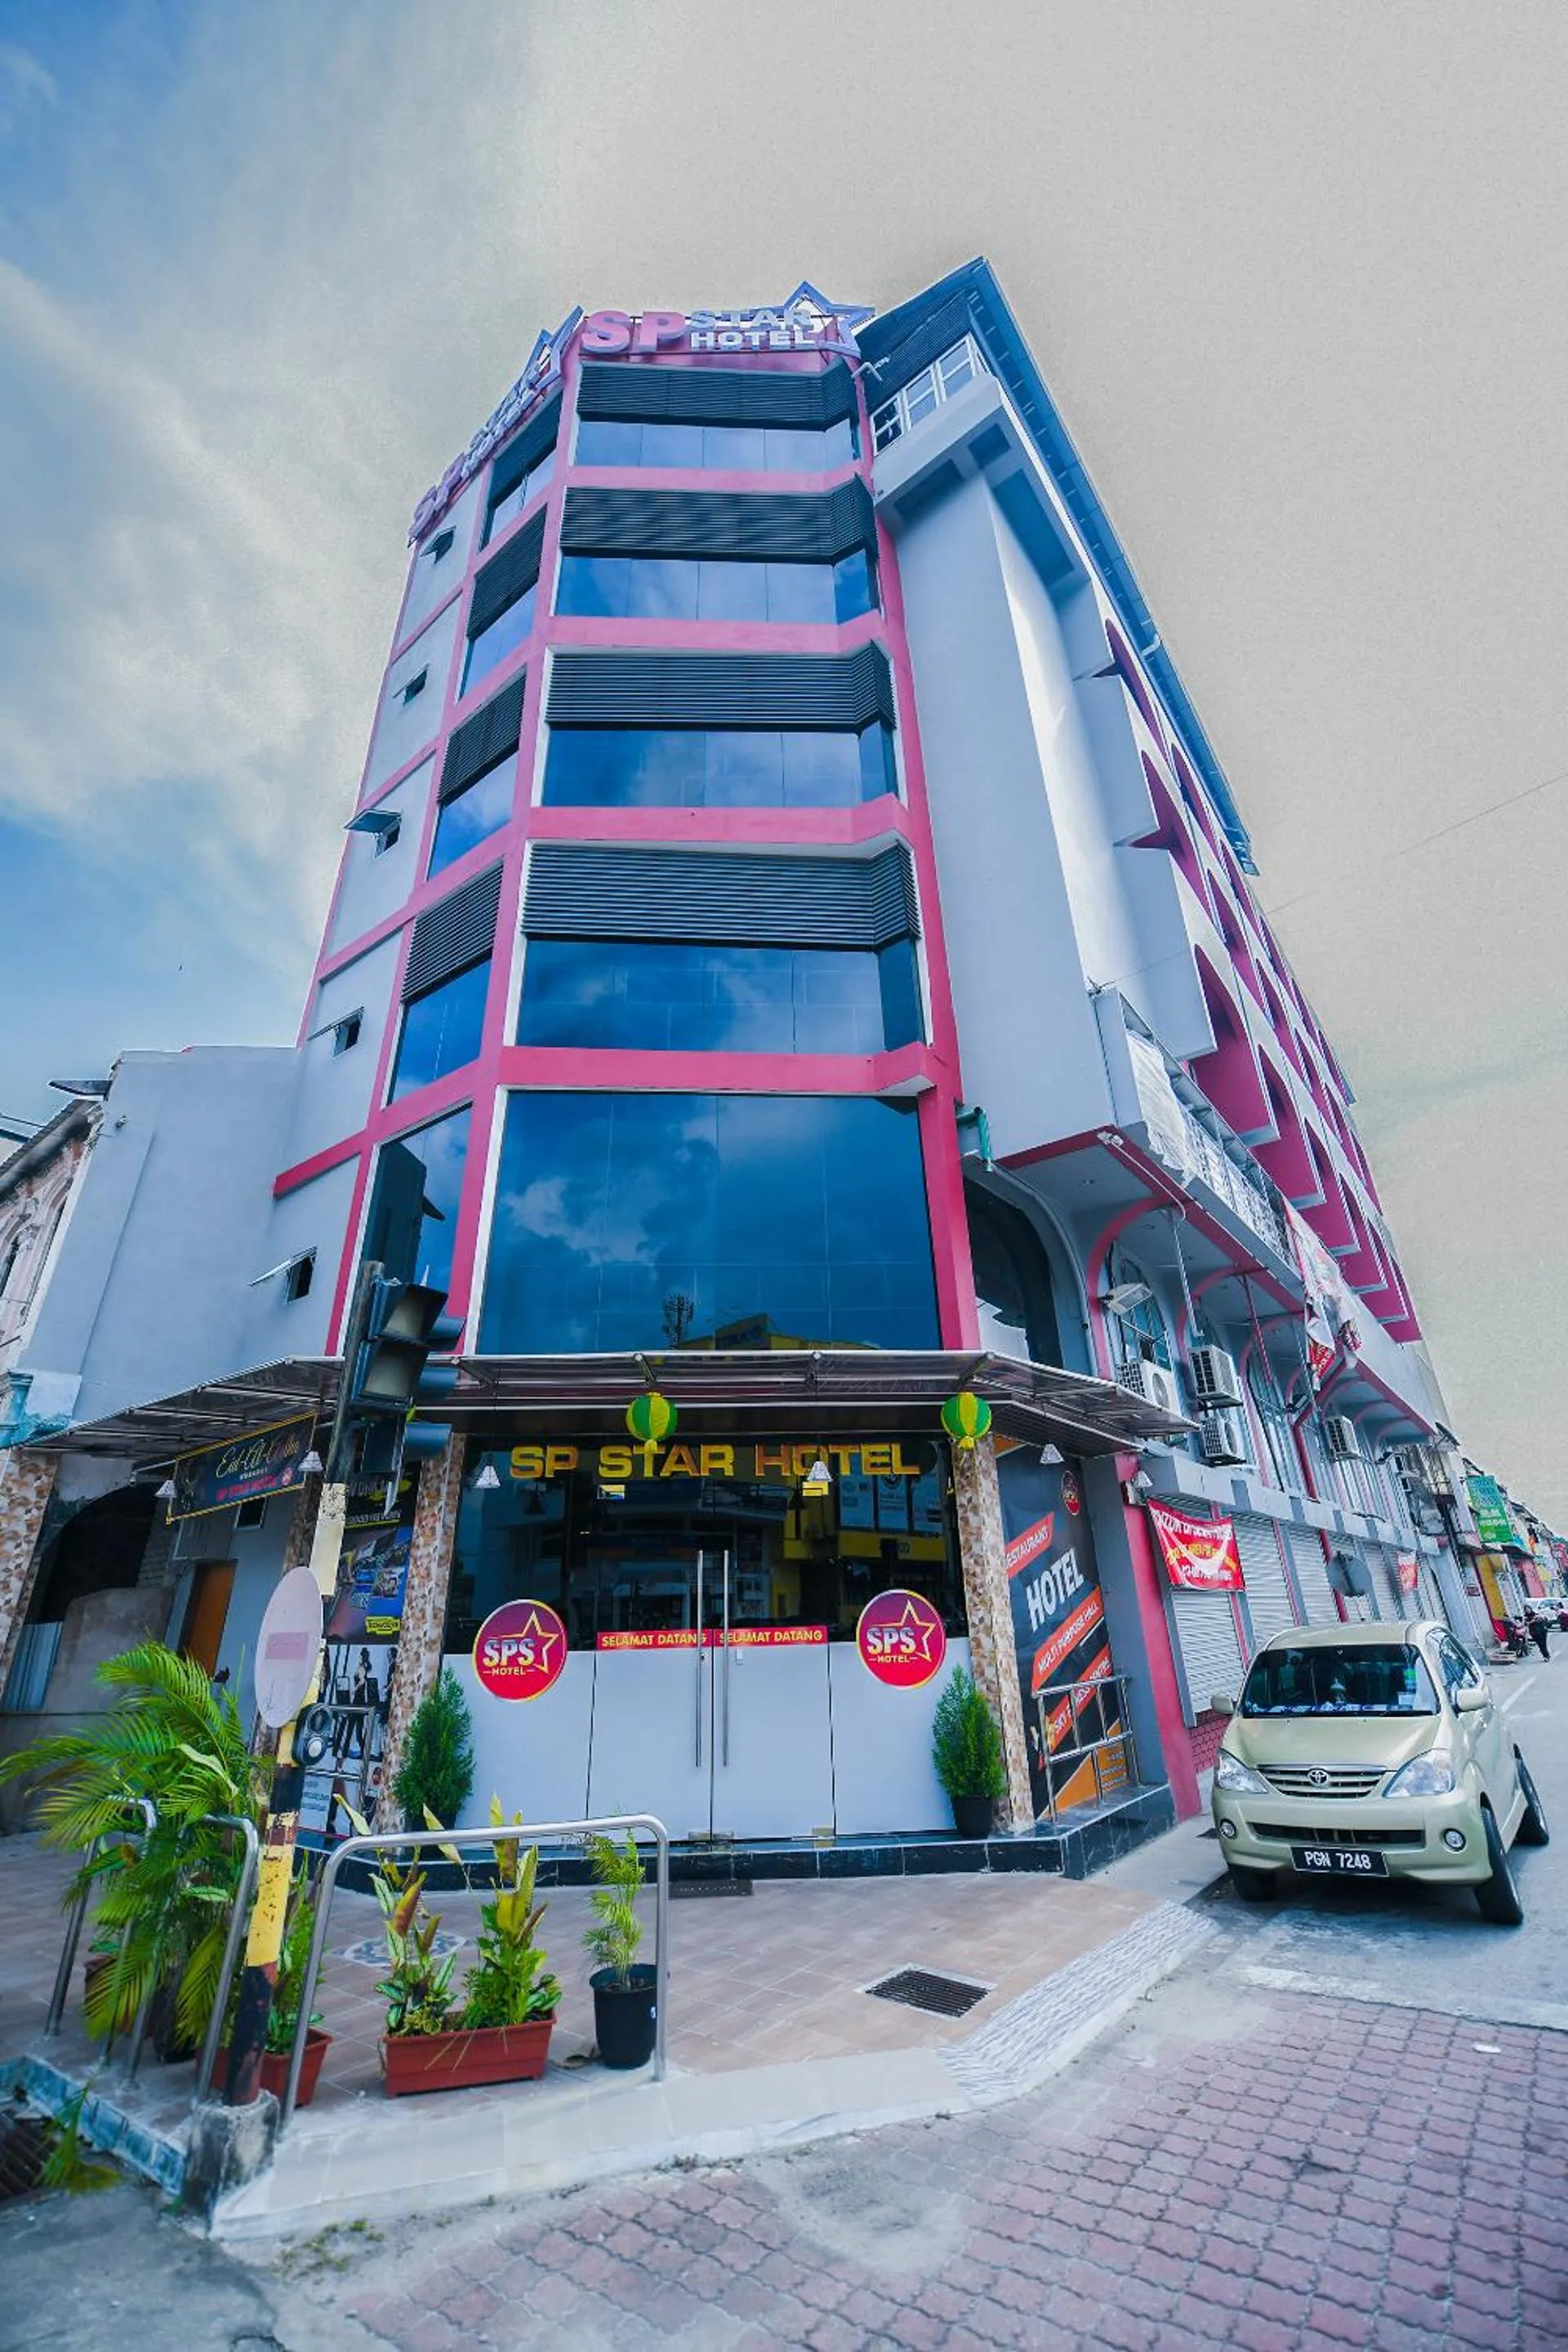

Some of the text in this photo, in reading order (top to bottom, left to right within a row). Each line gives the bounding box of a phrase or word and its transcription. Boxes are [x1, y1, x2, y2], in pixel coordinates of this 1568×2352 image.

[581, 310, 817, 353] SP STAR
[691, 330, 816, 351] HOTEL
[510, 1443, 920, 1479] SP STAR HOTEL
[1005, 1525, 1049, 1567] ESTAURANT
[1026, 1548, 1085, 1633] HOTEL
[601, 1634, 654, 1646] SELAMAT
[719, 1629, 823, 1644] SELAMAT DATANG
[866, 1627, 916, 1655] SPS
[483, 1638, 535, 1667] SPS
[877, 1655, 911, 1664] HOTEL
[492, 1667, 527, 1676] HOTEL
[1304, 1851, 1372, 1870] PGN 7248
